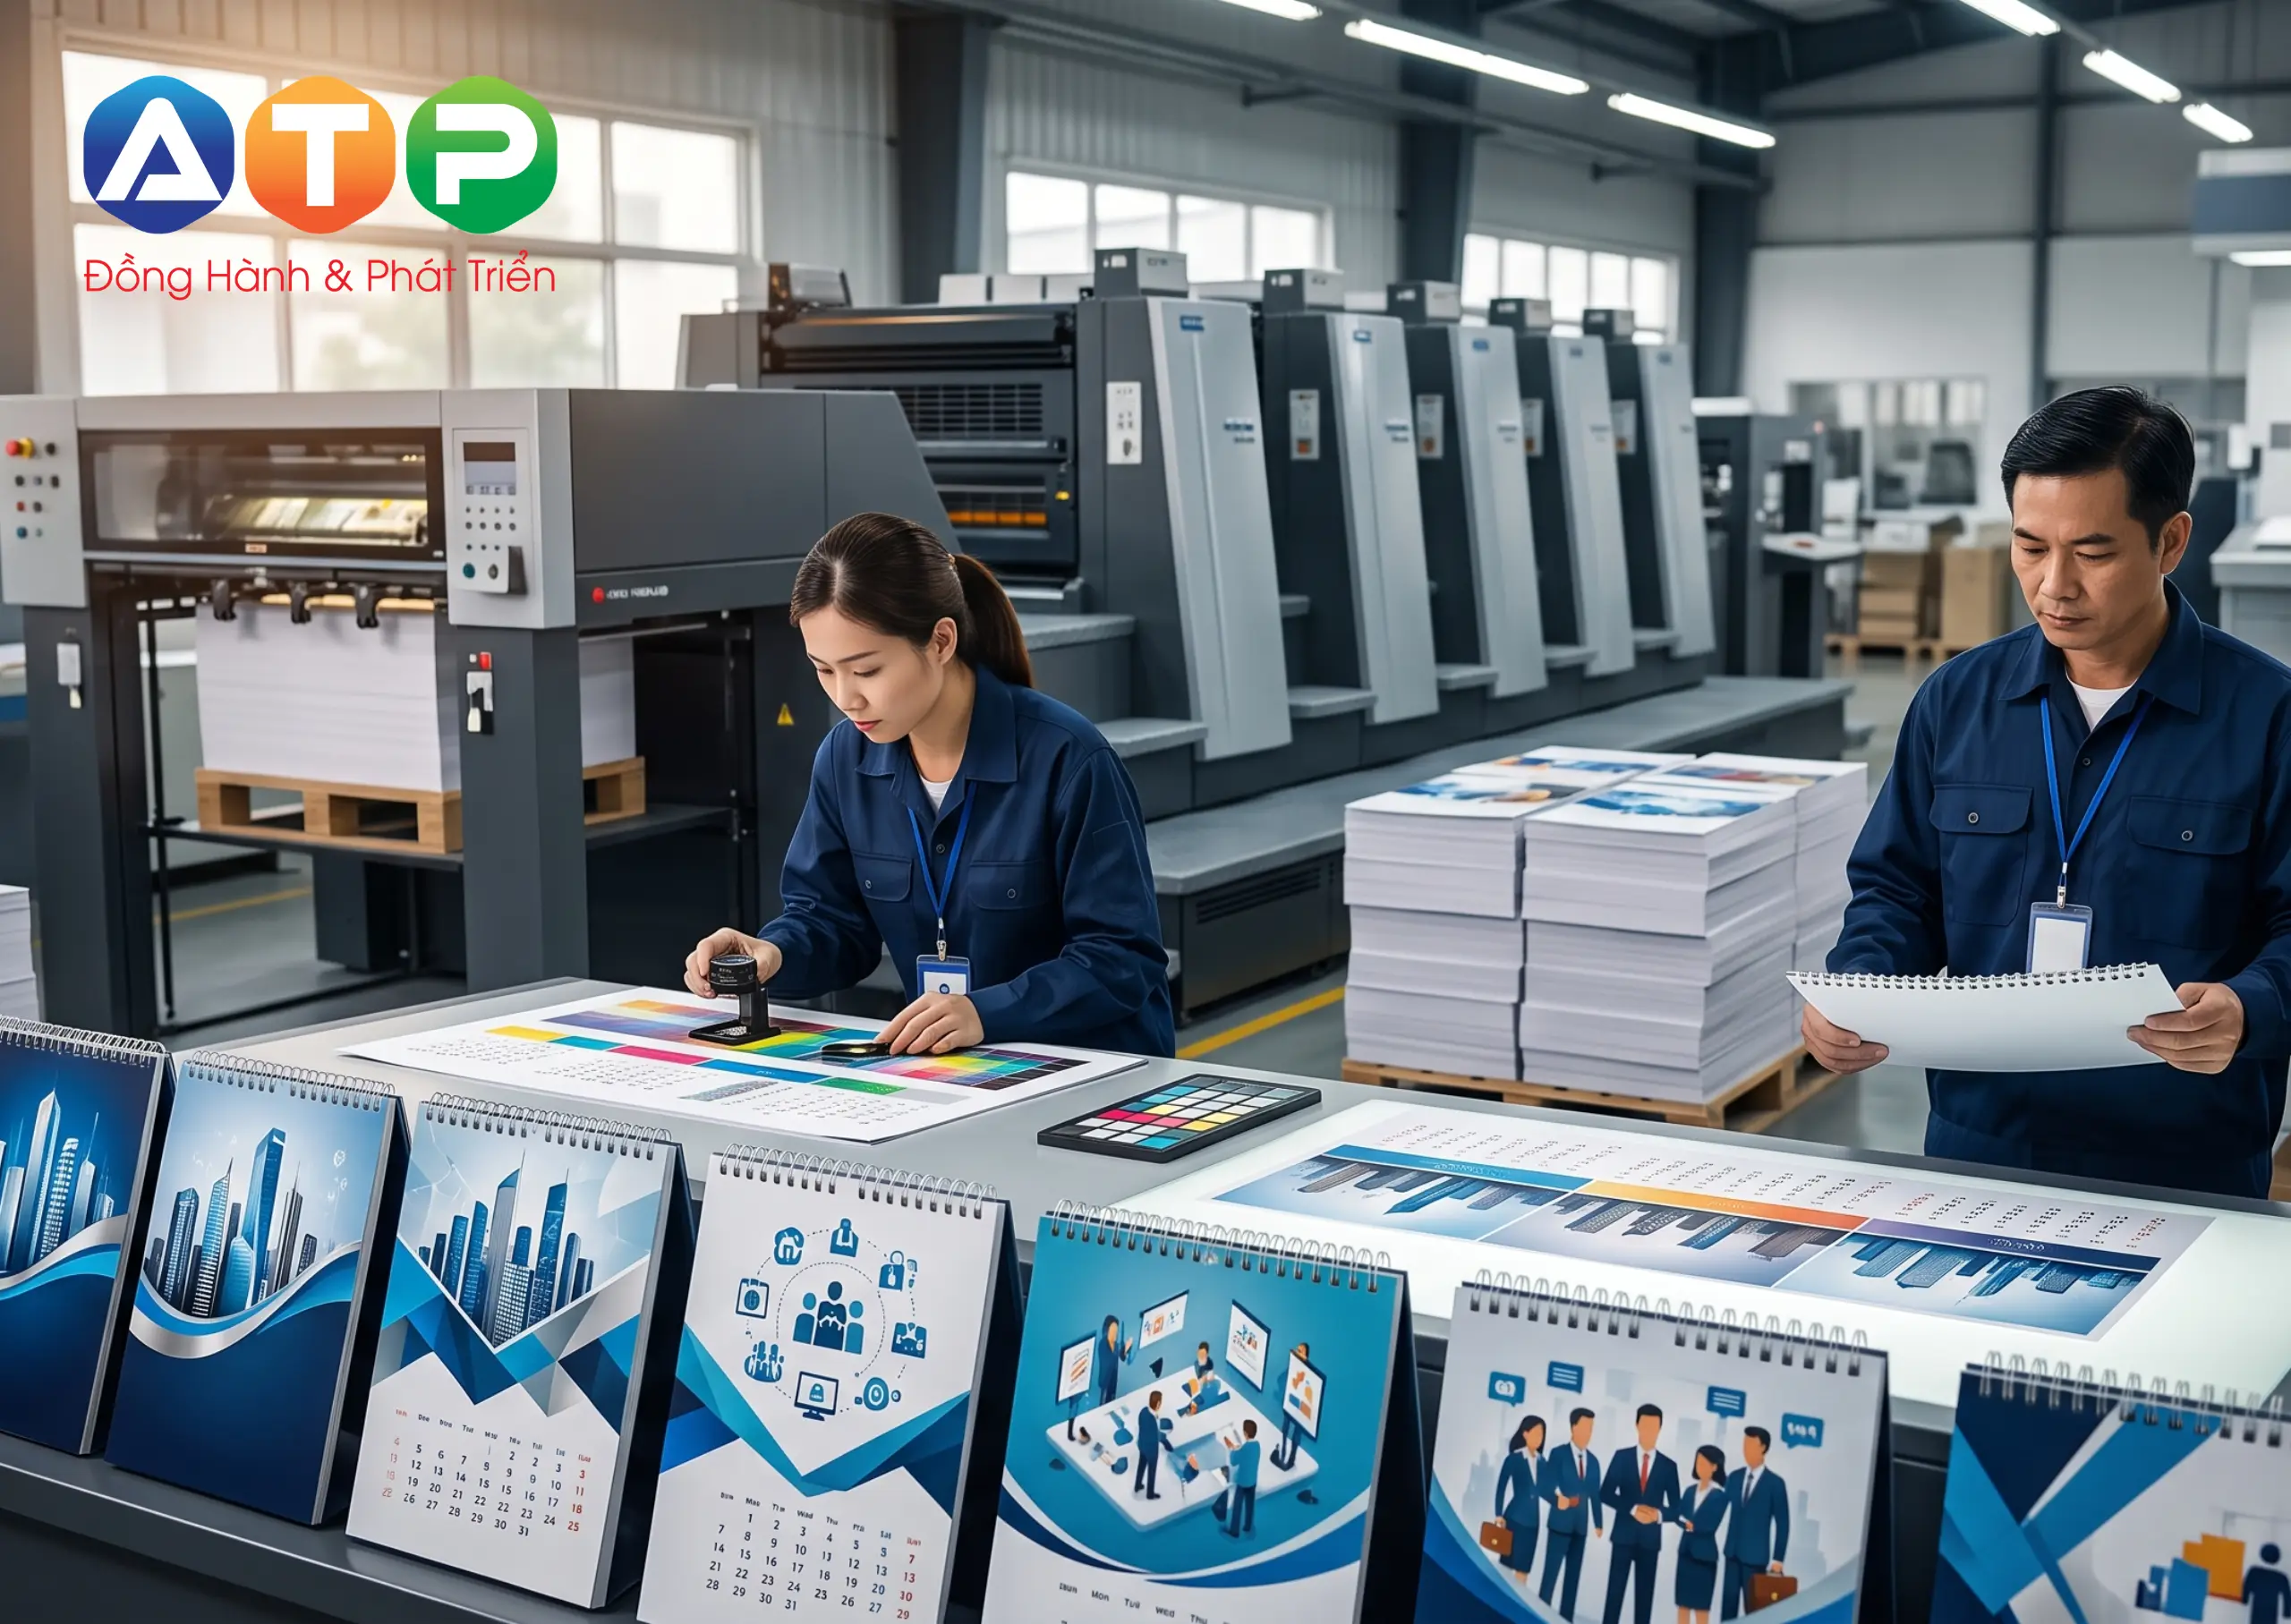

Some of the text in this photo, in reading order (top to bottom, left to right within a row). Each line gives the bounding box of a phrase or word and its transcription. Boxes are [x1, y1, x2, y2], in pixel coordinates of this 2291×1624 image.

[413, 1460, 421, 1470] 12
[434, 1467, 442, 1475] 13
[456, 1472, 465, 1482] 14
[502, 1485, 511, 1494] 15
[525, 1492, 534, 1501] 16
[549, 1497, 558, 1507] 17
[573, 1504, 582, 1514] 18
[416, 1444, 422, 1453] 5
[439, 1450, 444, 1458] 6
[462, 1456, 466, 1464] 7
[507, 1468, 512, 1477] 9
[551, 1480, 561, 1490] 10
[576, 1486, 583, 1496] 11
[509, 1451, 515, 1460] 2
[532, 1458, 538, 1467] 2
[556, 1464, 561, 1472] 3
[580, 1470, 584, 1479] 3
[404, 1493, 414, 1503] 26
[426, 1500, 438, 1509] 27
[448, 1506, 460, 1517] 28
[472, 1513, 482, 1523] 29
[494, 1519, 507, 1529] 30
[518, 1526, 528, 1536] 31
[409, 1476, 418, 1486] 19
[430, 1484, 440, 1492] 20
[453, 1490, 462, 1499] 21
[474, 1495, 486, 1506] 22
[498, 1502, 509, 1512] 22
[521, 1509, 532, 1518] 23
[544, 1515, 555, 1525] 24
[568, 1521, 579, 1531] 25
[719, 1525, 724, 1534] 7
[745, 1532, 751, 1541] 8
[771, 1538, 777, 1548] 9
[796, 1544, 806, 1555] 10
[849, 1558, 859, 1569] 12
[877, 1565, 887, 1576] 13
[905, 1572, 915, 1583] 13
[749, 1514, 752, 1523] 1
[774, 1520, 779, 1530] 2
[800, 1526, 805, 1536] 3
[827, 1534, 832, 1542] 4
[854, 1540, 859, 1550] 5
[909, 1554, 915, 1564] 7
[710, 1561, 909, 1620] 21 22 23 24 23 26 27 29
[714, 1543, 724, 1552] 14
[741, 1549, 751, 1560] 15
[767, 1556, 777, 1566] 16
[793, 1562, 804, 1573] 17
[820, 1569, 830, 1580] 18
[847, 1577, 857, 1587] 19
[872, 1584, 885, 1594] 20
[706, 1579, 796, 1611] 28 29 30 31
[1092, 1591, 1109, 1601] Mon
